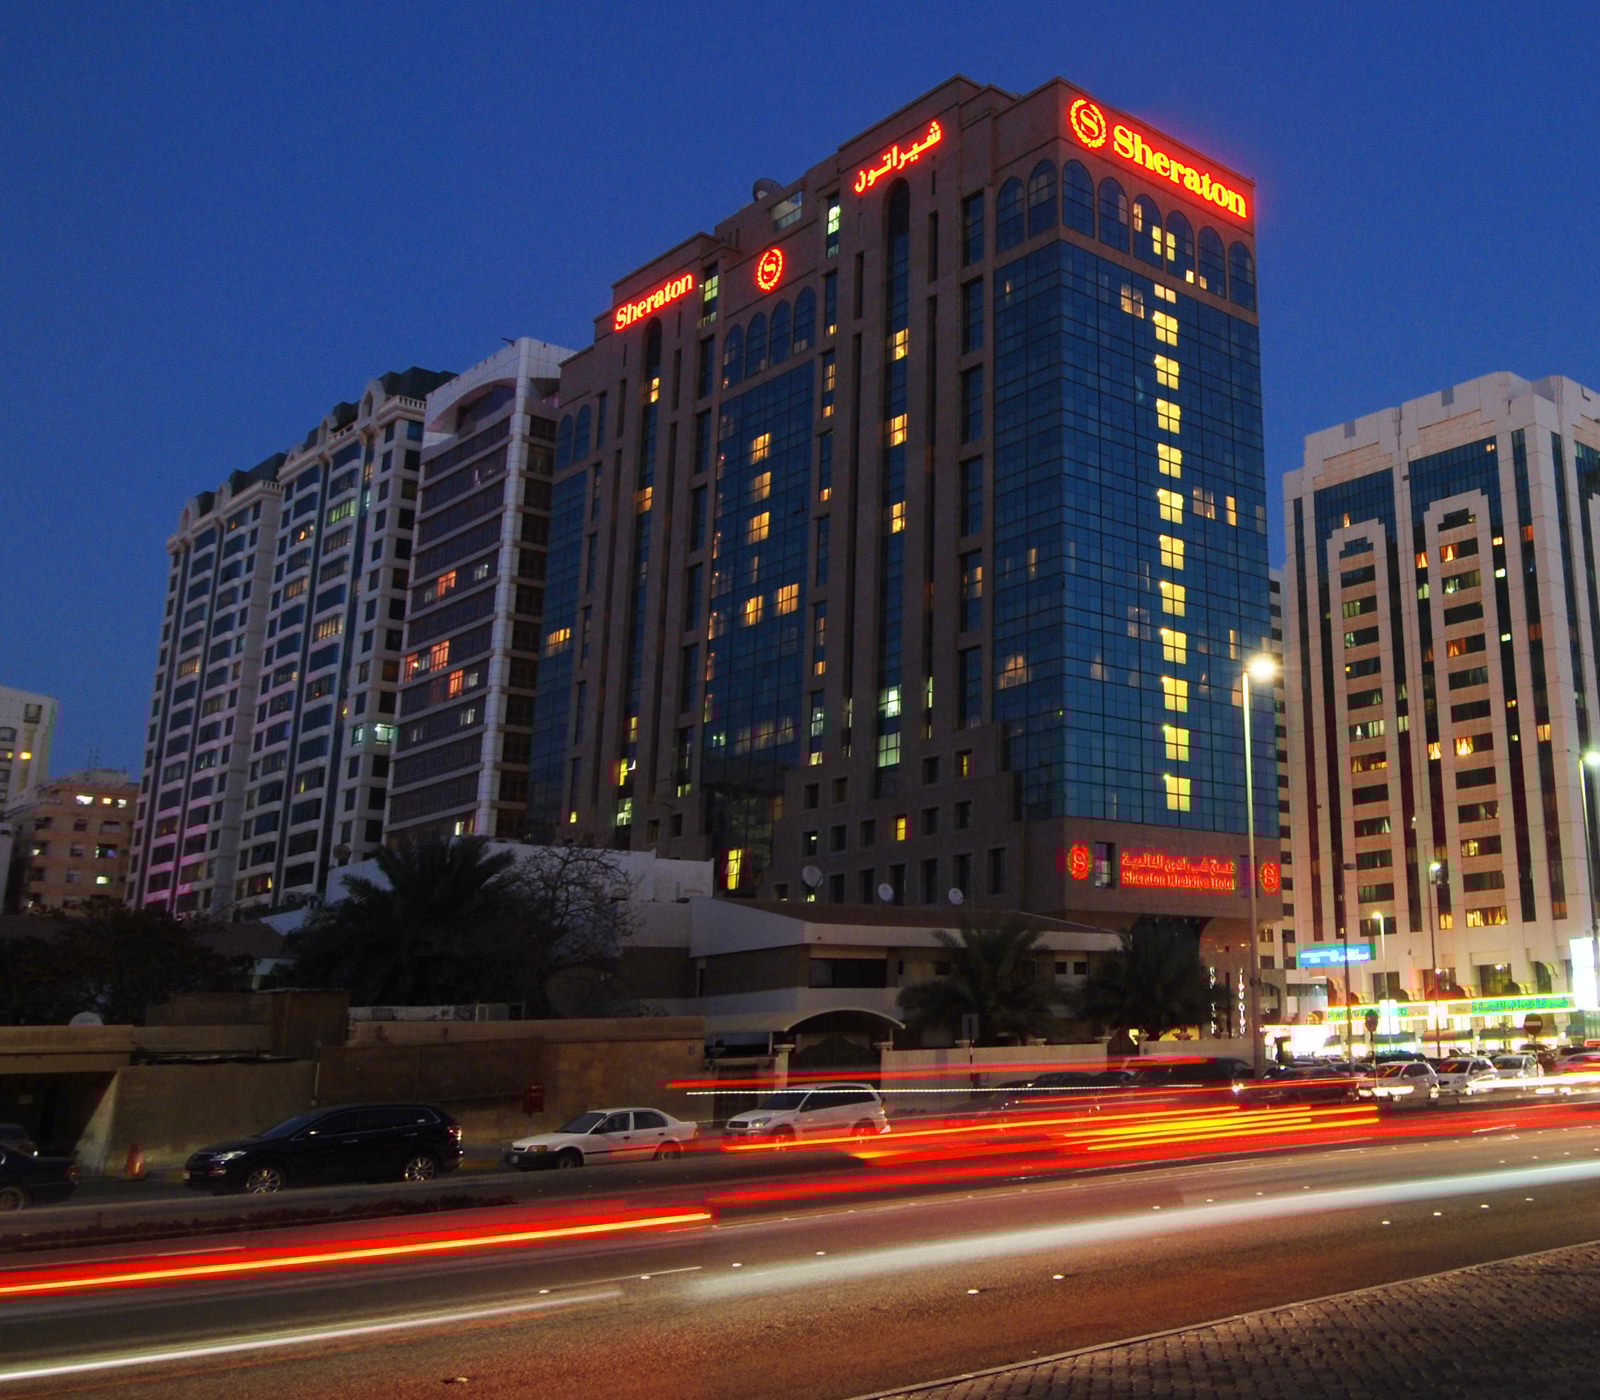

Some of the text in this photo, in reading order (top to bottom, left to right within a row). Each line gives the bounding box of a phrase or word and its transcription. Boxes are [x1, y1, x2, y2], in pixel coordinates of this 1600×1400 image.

[854, 120, 942, 193] شيراتون
[1113, 125, 1247, 218] Sheraton
[614, 273, 693, 331] Sheraton
[1122, 871, 1166, 885] Sheraton
[1210, 877, 1235, 890] Hotel
